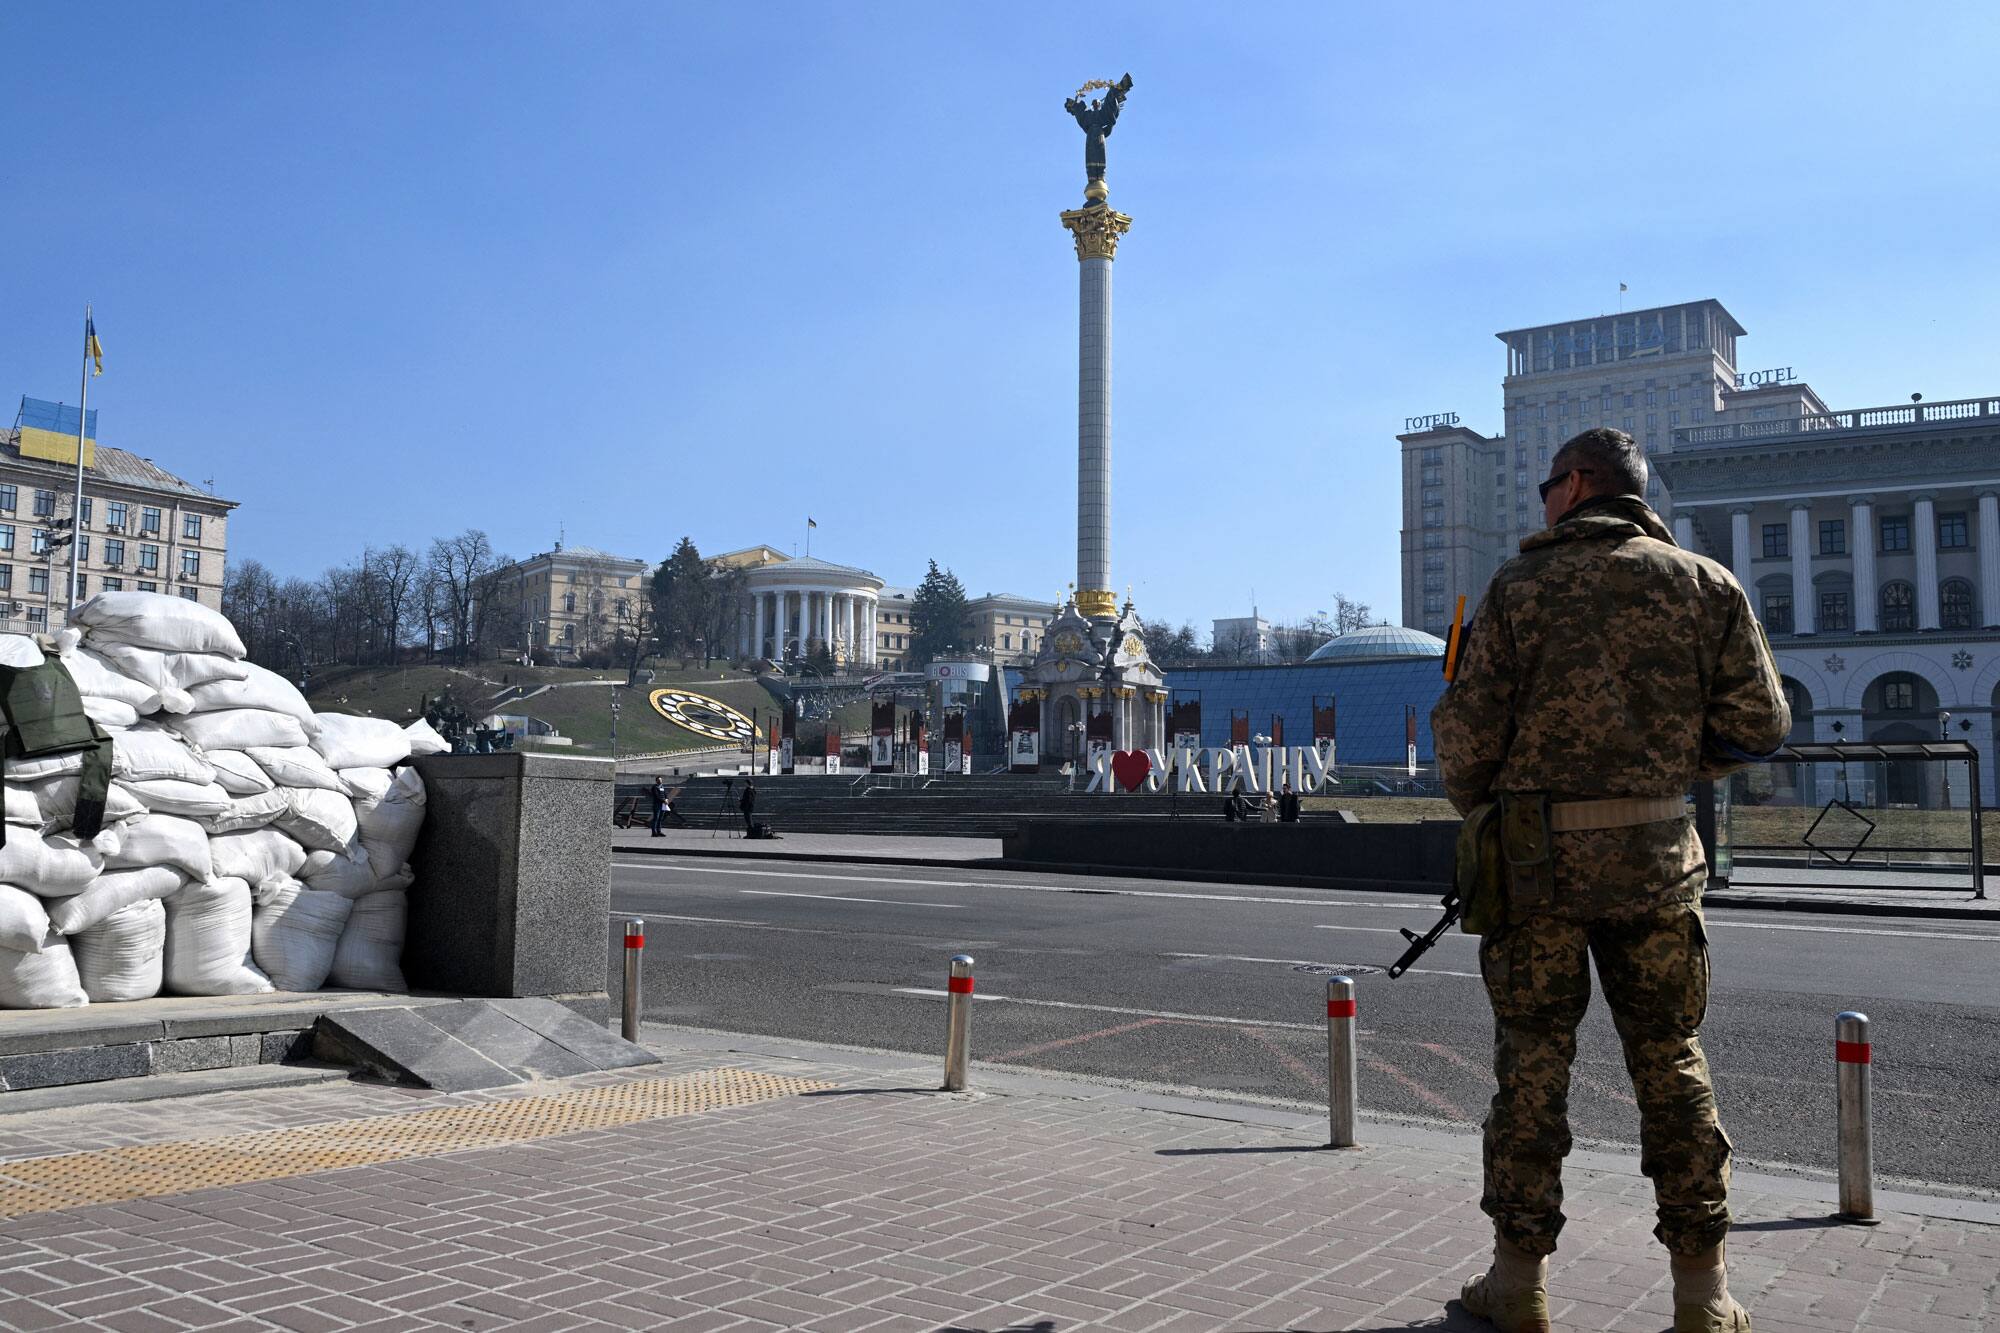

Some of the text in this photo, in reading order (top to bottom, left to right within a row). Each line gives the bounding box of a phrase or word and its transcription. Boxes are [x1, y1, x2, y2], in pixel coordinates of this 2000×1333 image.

[1733, 366, 1798, 387] HOTEL
[1405, 411, 1460, 430] ГОТЕЛЬ
[932, 665, 968, 678] GLOBUS
[1085, 735, 1337, 793] Я УКРАЇНУ
